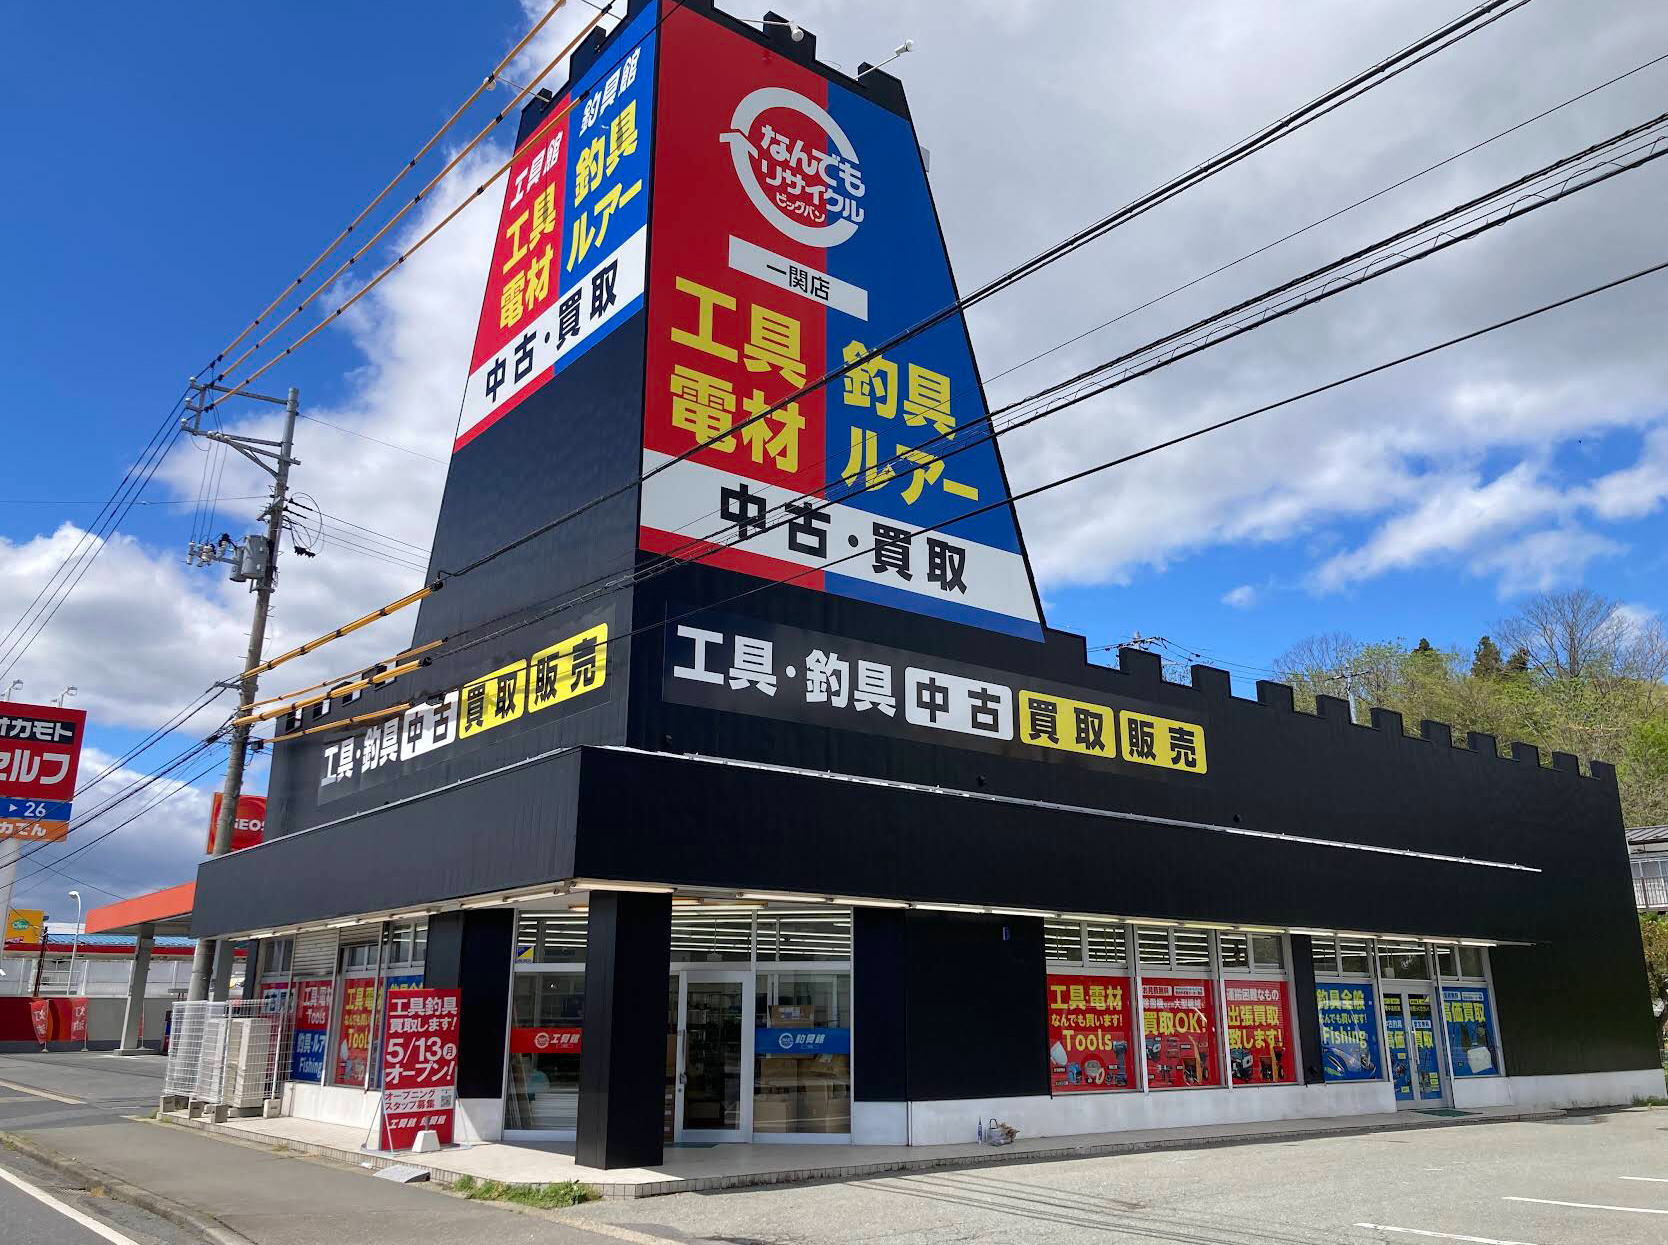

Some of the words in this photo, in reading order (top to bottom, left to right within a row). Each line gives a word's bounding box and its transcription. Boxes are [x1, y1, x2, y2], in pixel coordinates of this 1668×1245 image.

[579, 47, 641, 138] 釣具館
[509, 130, 564, 210] 工具館
[575, 99, 638, 204] 釣具
[760, 124, 866, 198] なんでも
[566, 178, 643, 272] ルアー
[761, 157, 865, 223] リサイクル
[775, 191, 826, 223] ビッグバン
[502, 181, 557, 277] 工具
[498, 245, 555, 331] 電材
[766, 263, 830, 302] 一関店
[485, 257, 619, 404] 中古・買取
[670, 275, 808, 390] 工具
[670, 362, 807, 474] 電材
[842, 339, 956, 441] 釣具
[841, 425, 979, 506] ルアー
[720, 483, 967, 595] 中古・買取
[320, 716, 400, 787] 工具・釣具
[407, 701, 452, 754] 中古
[464, 675, 519, 733] 買取
[533, 637, 598, 706] 販売
[673, 623, 898, 718] 工具・釣具
[914, 676, 1002, 733] 中古
[1028, 702, 1106, 752] 買取
[1127, 717, 1198, 769] 販売
[24, 802, 46, 817] 26
[305, 1008, 327, 1025] Tools
[389, 996, 458, 1016] 工具釣具
[389, 1016, 457, 1033] 買取します!
[1051, 1013, 1123, 1028] なんでも買います!
[1062, 1028, 1113, 1052] Tools
[1227, 1004, 1280, 1026] 出張買取
[1322, 1026, 1368, 1050] Fishing
[385, 1061, 455, 1085] オープン!
[385, 1089, 436, 1101] オープニング
[385, 1099, 435, 1111] スタッフ募集
